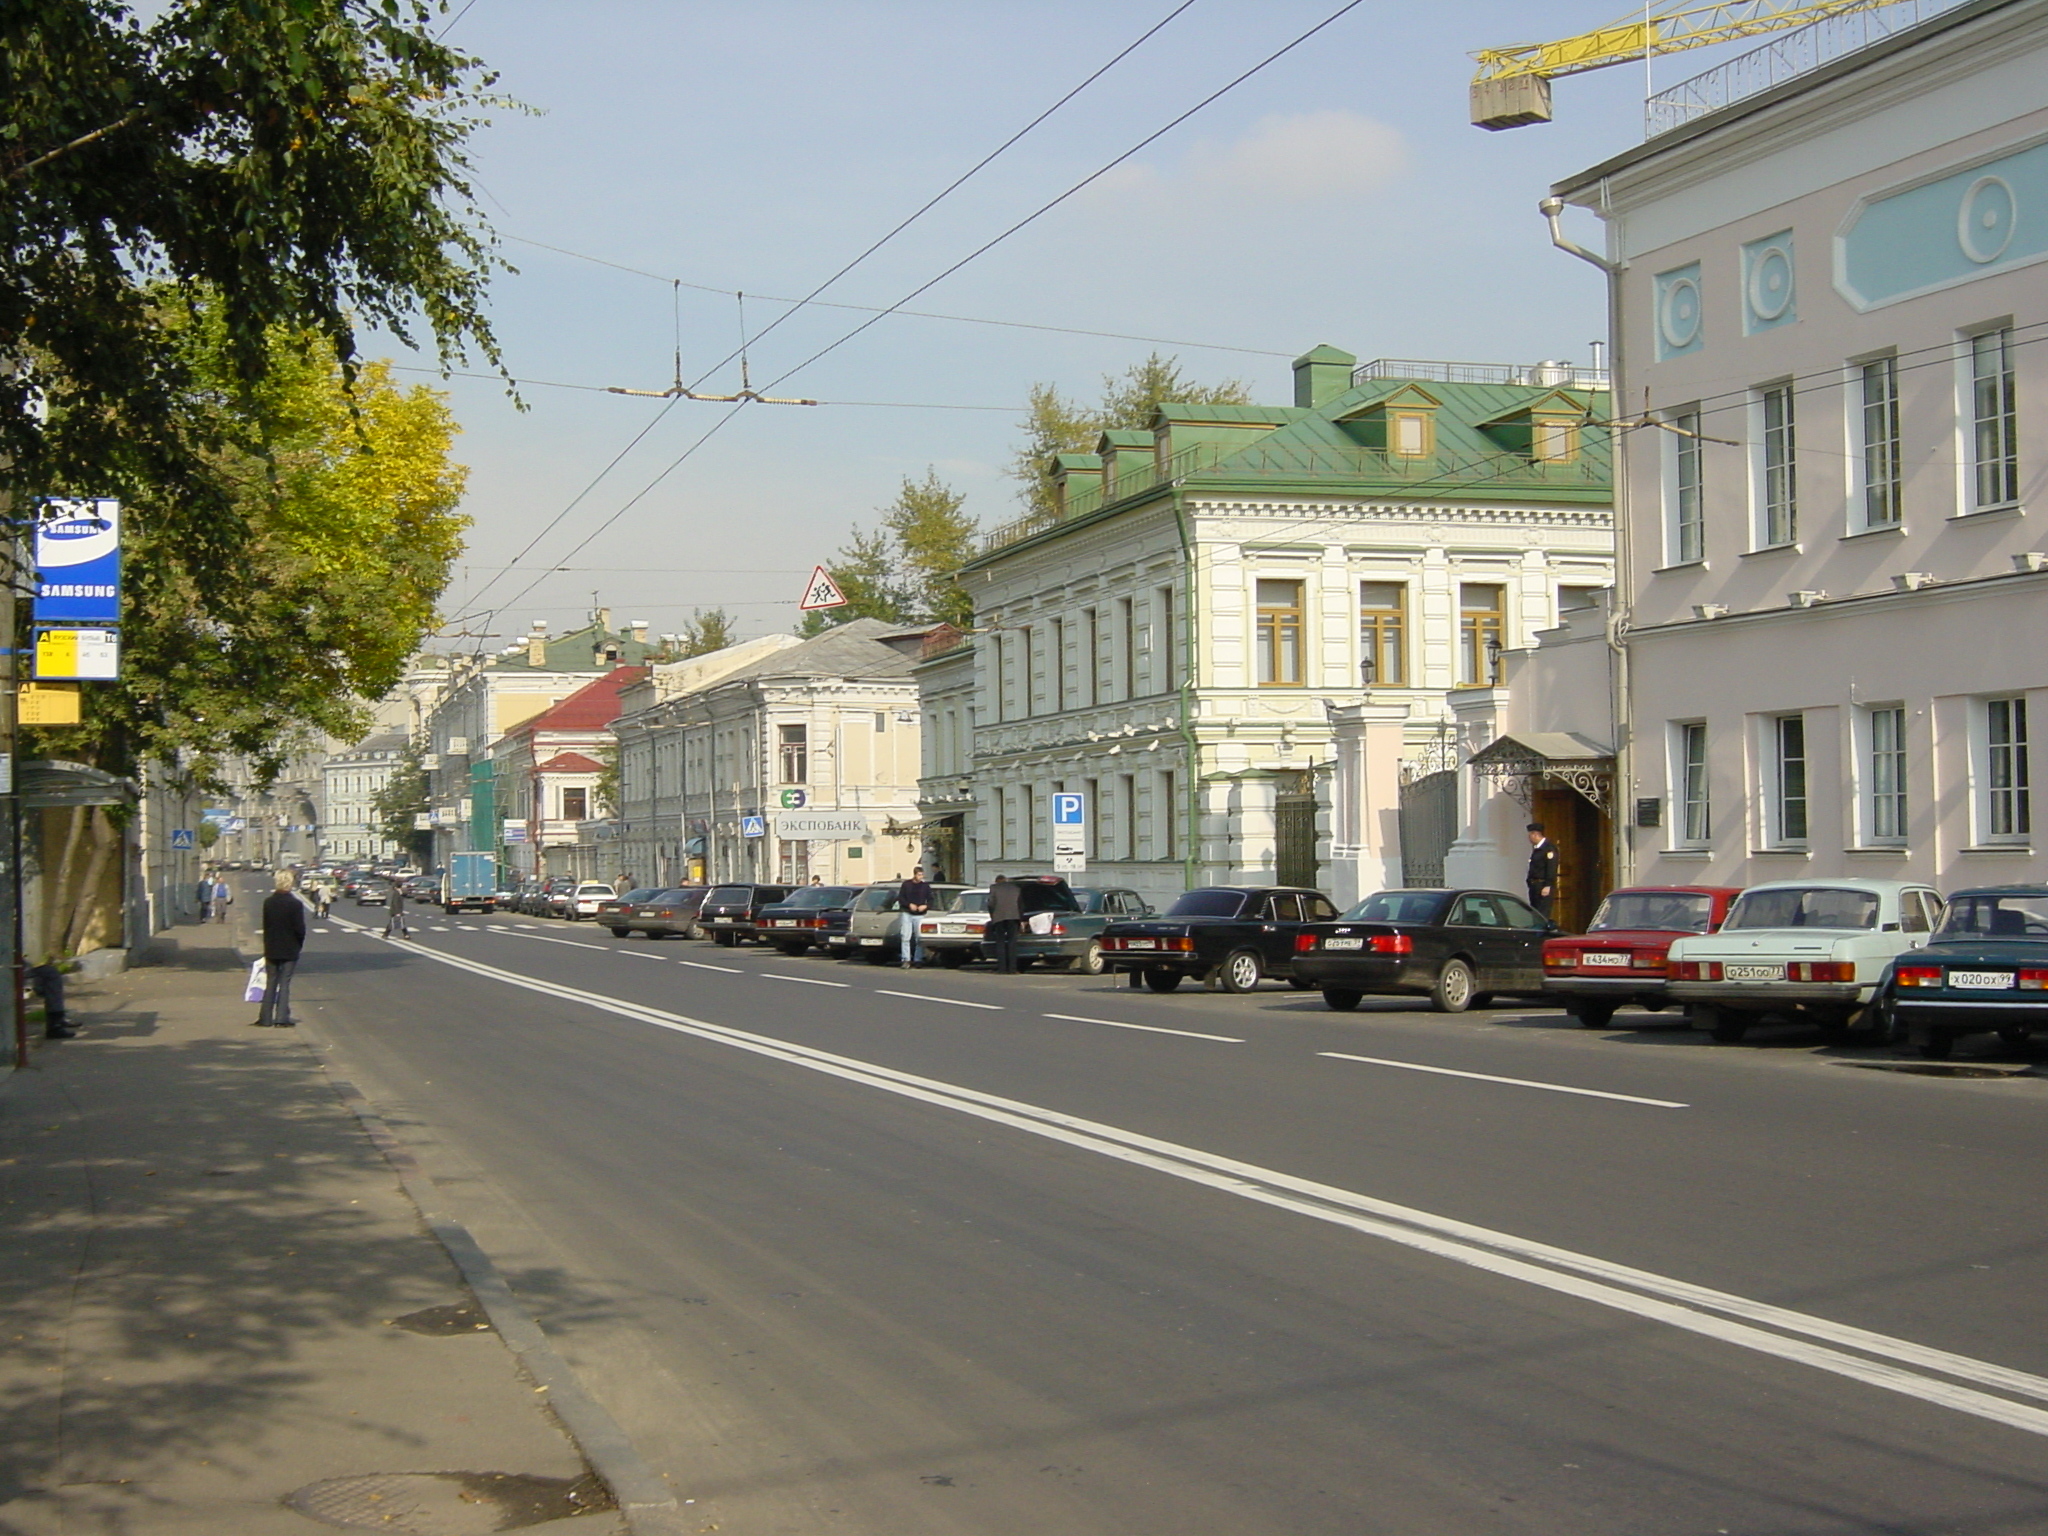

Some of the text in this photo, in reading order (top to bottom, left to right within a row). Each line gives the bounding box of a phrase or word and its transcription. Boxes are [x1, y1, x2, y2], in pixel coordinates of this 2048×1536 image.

[41, 584, 116, 598] SAMSUNG
[1061, 796, 1080, 823] P
[780, 820, 862, 831] ЭКСПОБАНК
